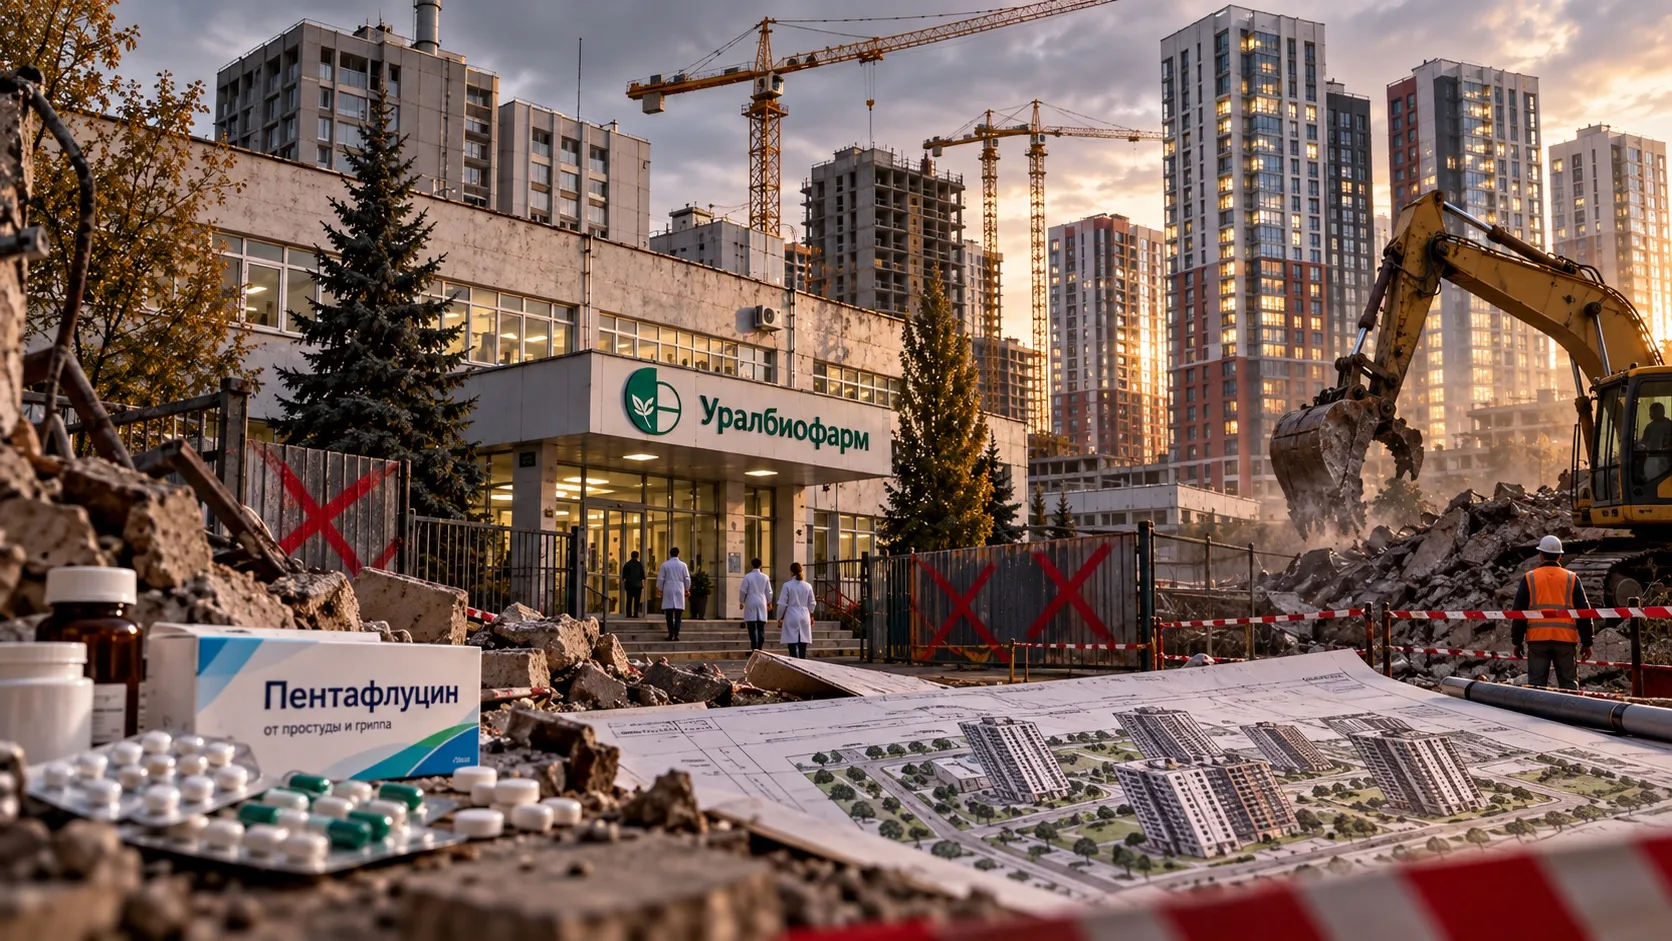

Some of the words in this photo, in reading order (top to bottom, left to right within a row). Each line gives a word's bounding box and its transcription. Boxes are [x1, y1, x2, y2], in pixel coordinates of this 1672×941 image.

[700, 395, 869, 454] Уралбиофарм
[264, 680, 459, 713] Пентафлуцин
[264, 725, 278, 736] от
[282, 722, 342, 737] простуды
[345, 722, 352, 732] и
[355, 720, 392, 733] гриппа
